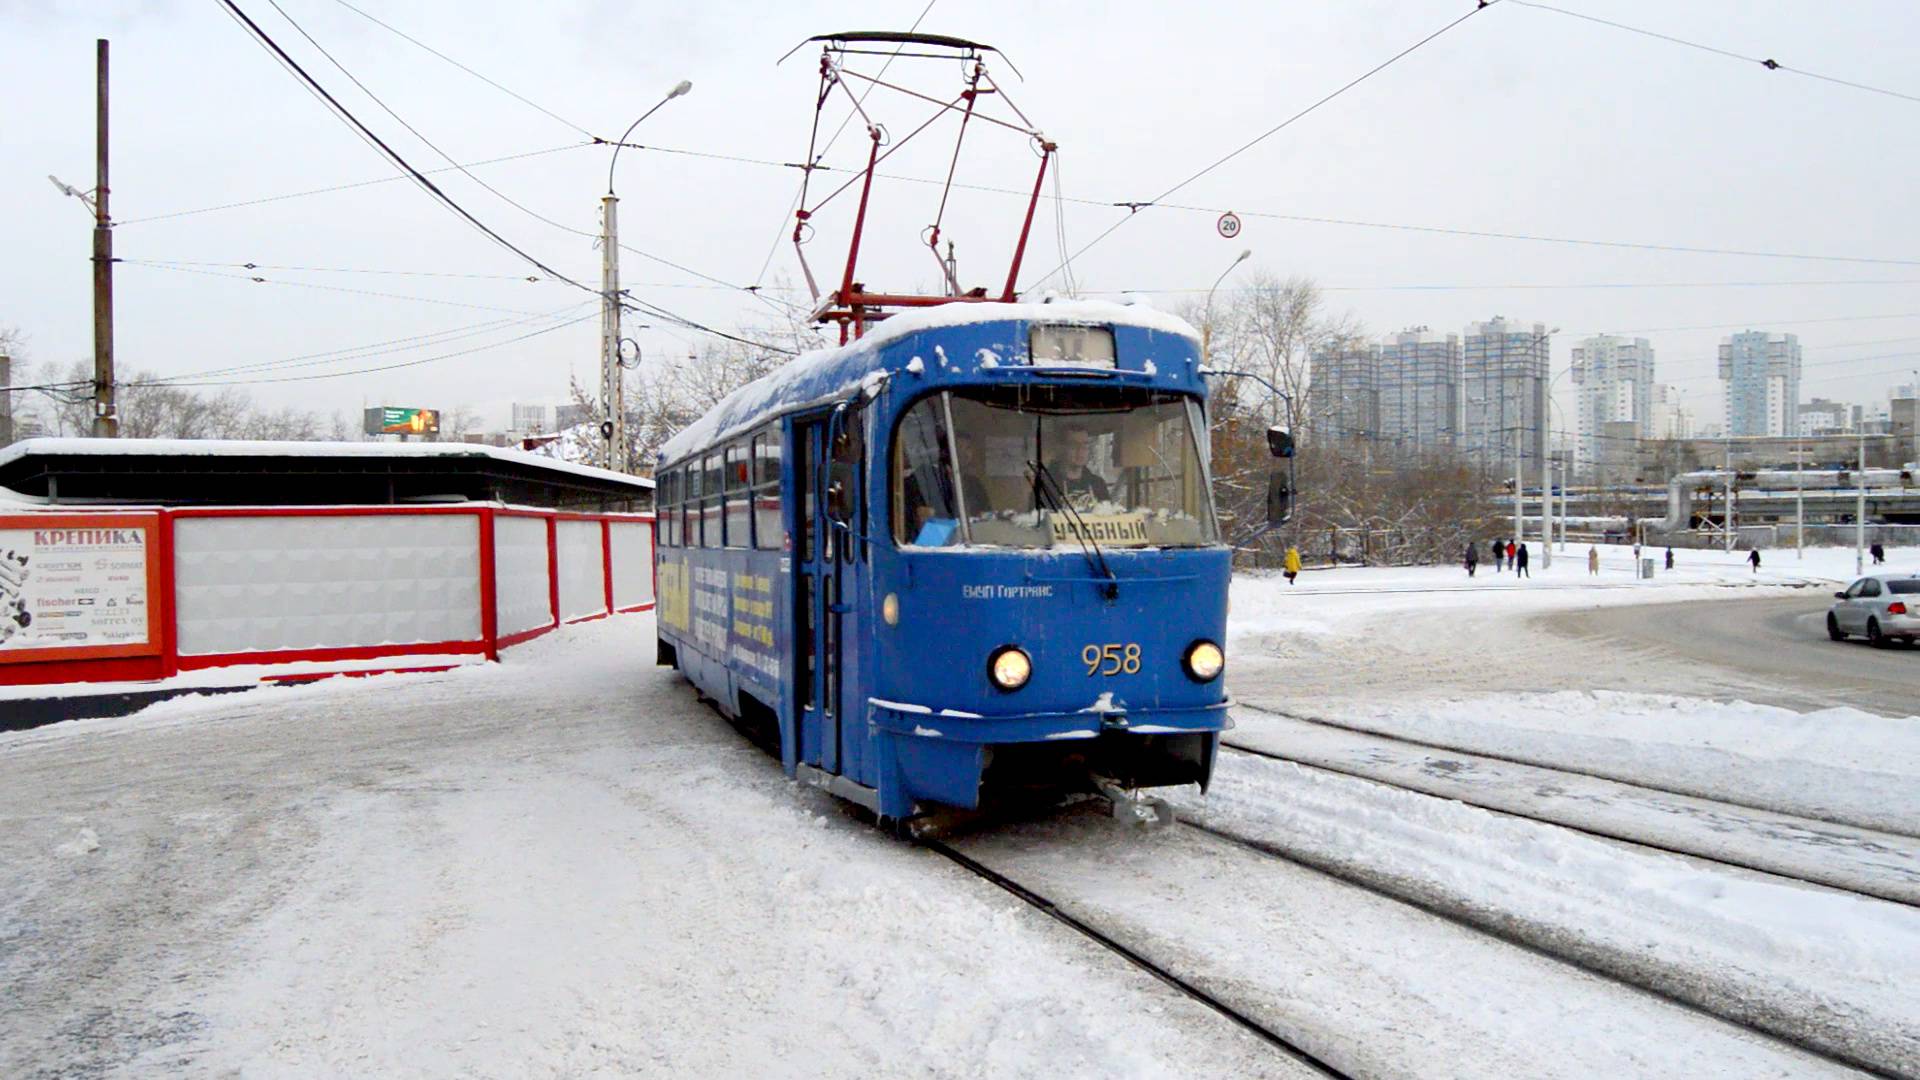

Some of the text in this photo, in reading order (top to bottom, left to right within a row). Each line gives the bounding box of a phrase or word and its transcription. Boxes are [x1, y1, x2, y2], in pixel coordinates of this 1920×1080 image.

[1223, 220, 1236, 231] 20
[34, 530, 143, 545] КРЕПИКА
[1053, 518, 1147, 540] УЧЕБНЫЙ
[1081, 643, 1141, 676] 958
